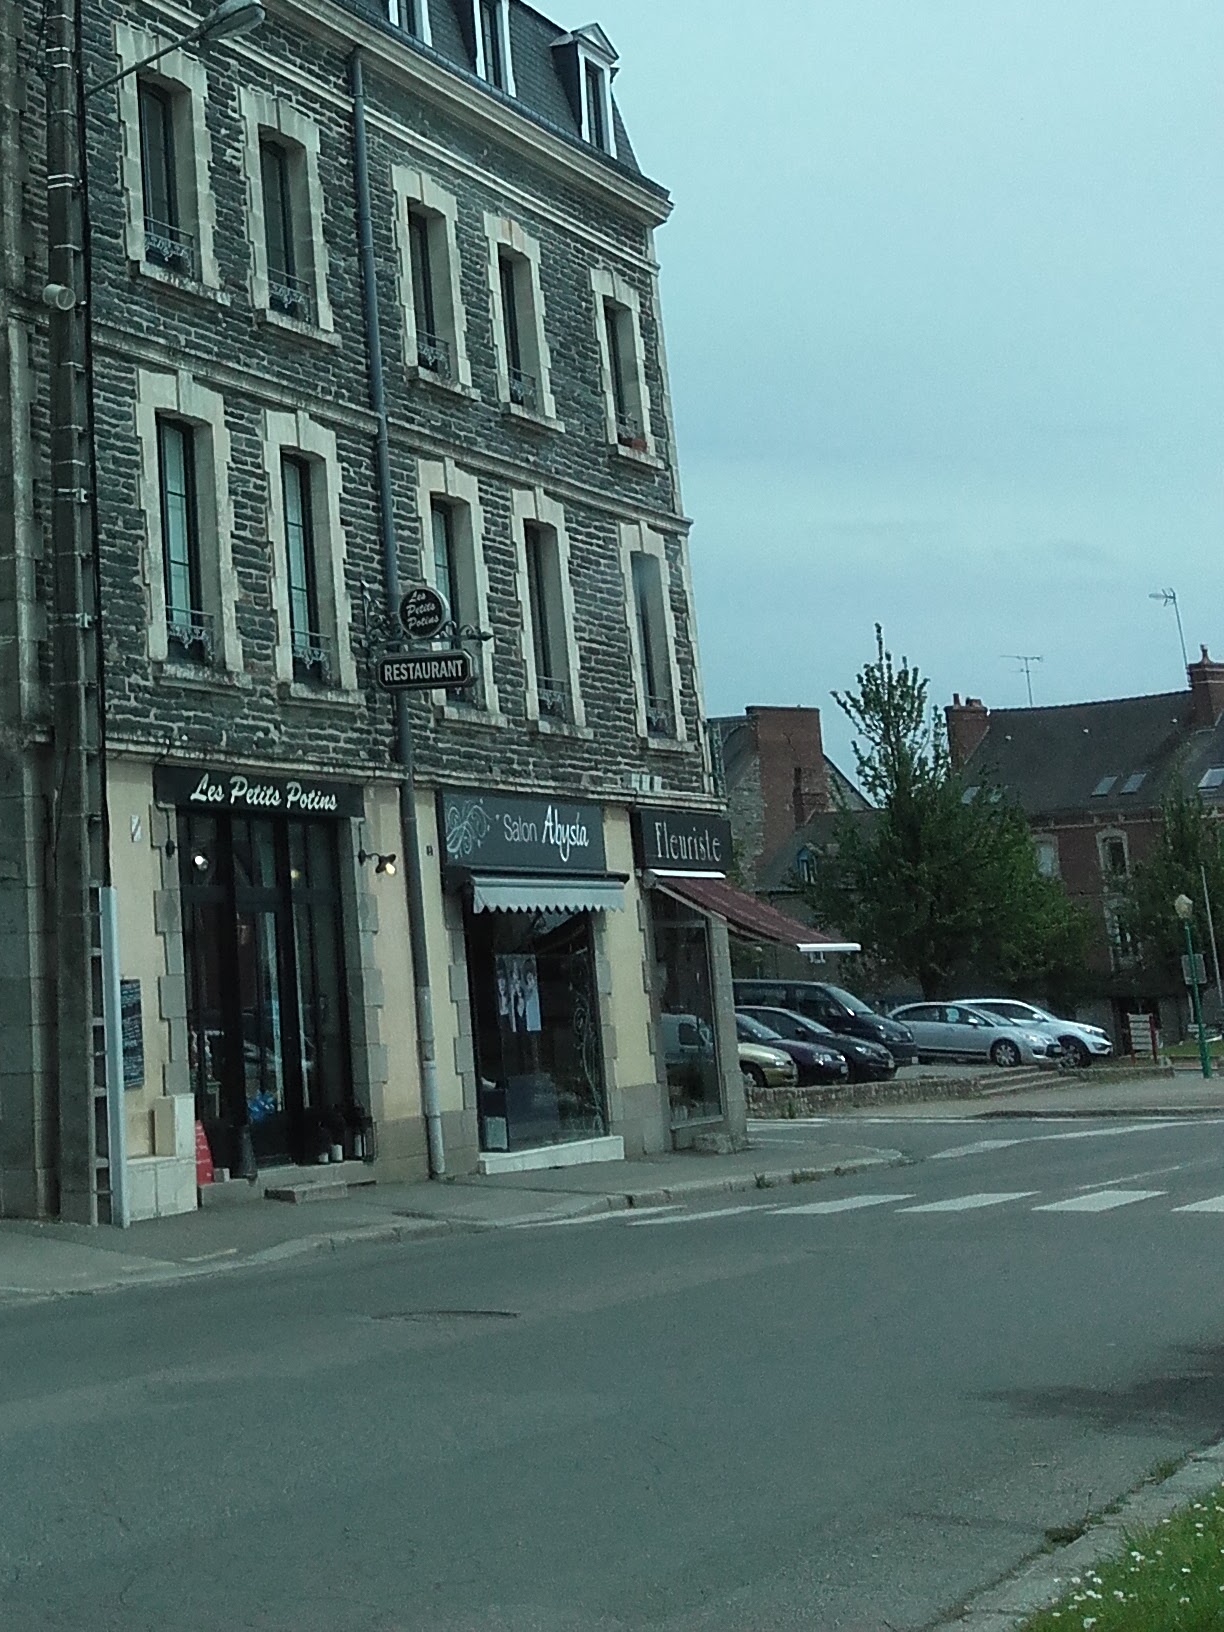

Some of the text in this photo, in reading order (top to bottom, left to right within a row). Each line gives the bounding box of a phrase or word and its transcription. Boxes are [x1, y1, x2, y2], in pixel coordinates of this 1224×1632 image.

[409, 591, 426, 603] Les
[406, 603, 435, 617] Petits
[407, 616, 439, 630] Potins
[384, 660, 464, 681] RESTAURANT
[190, 773, 337, 810] Les Petits Potins
[503, 814, 537, 843] Salon
[655, 821, 721, 862] Fleuriste
